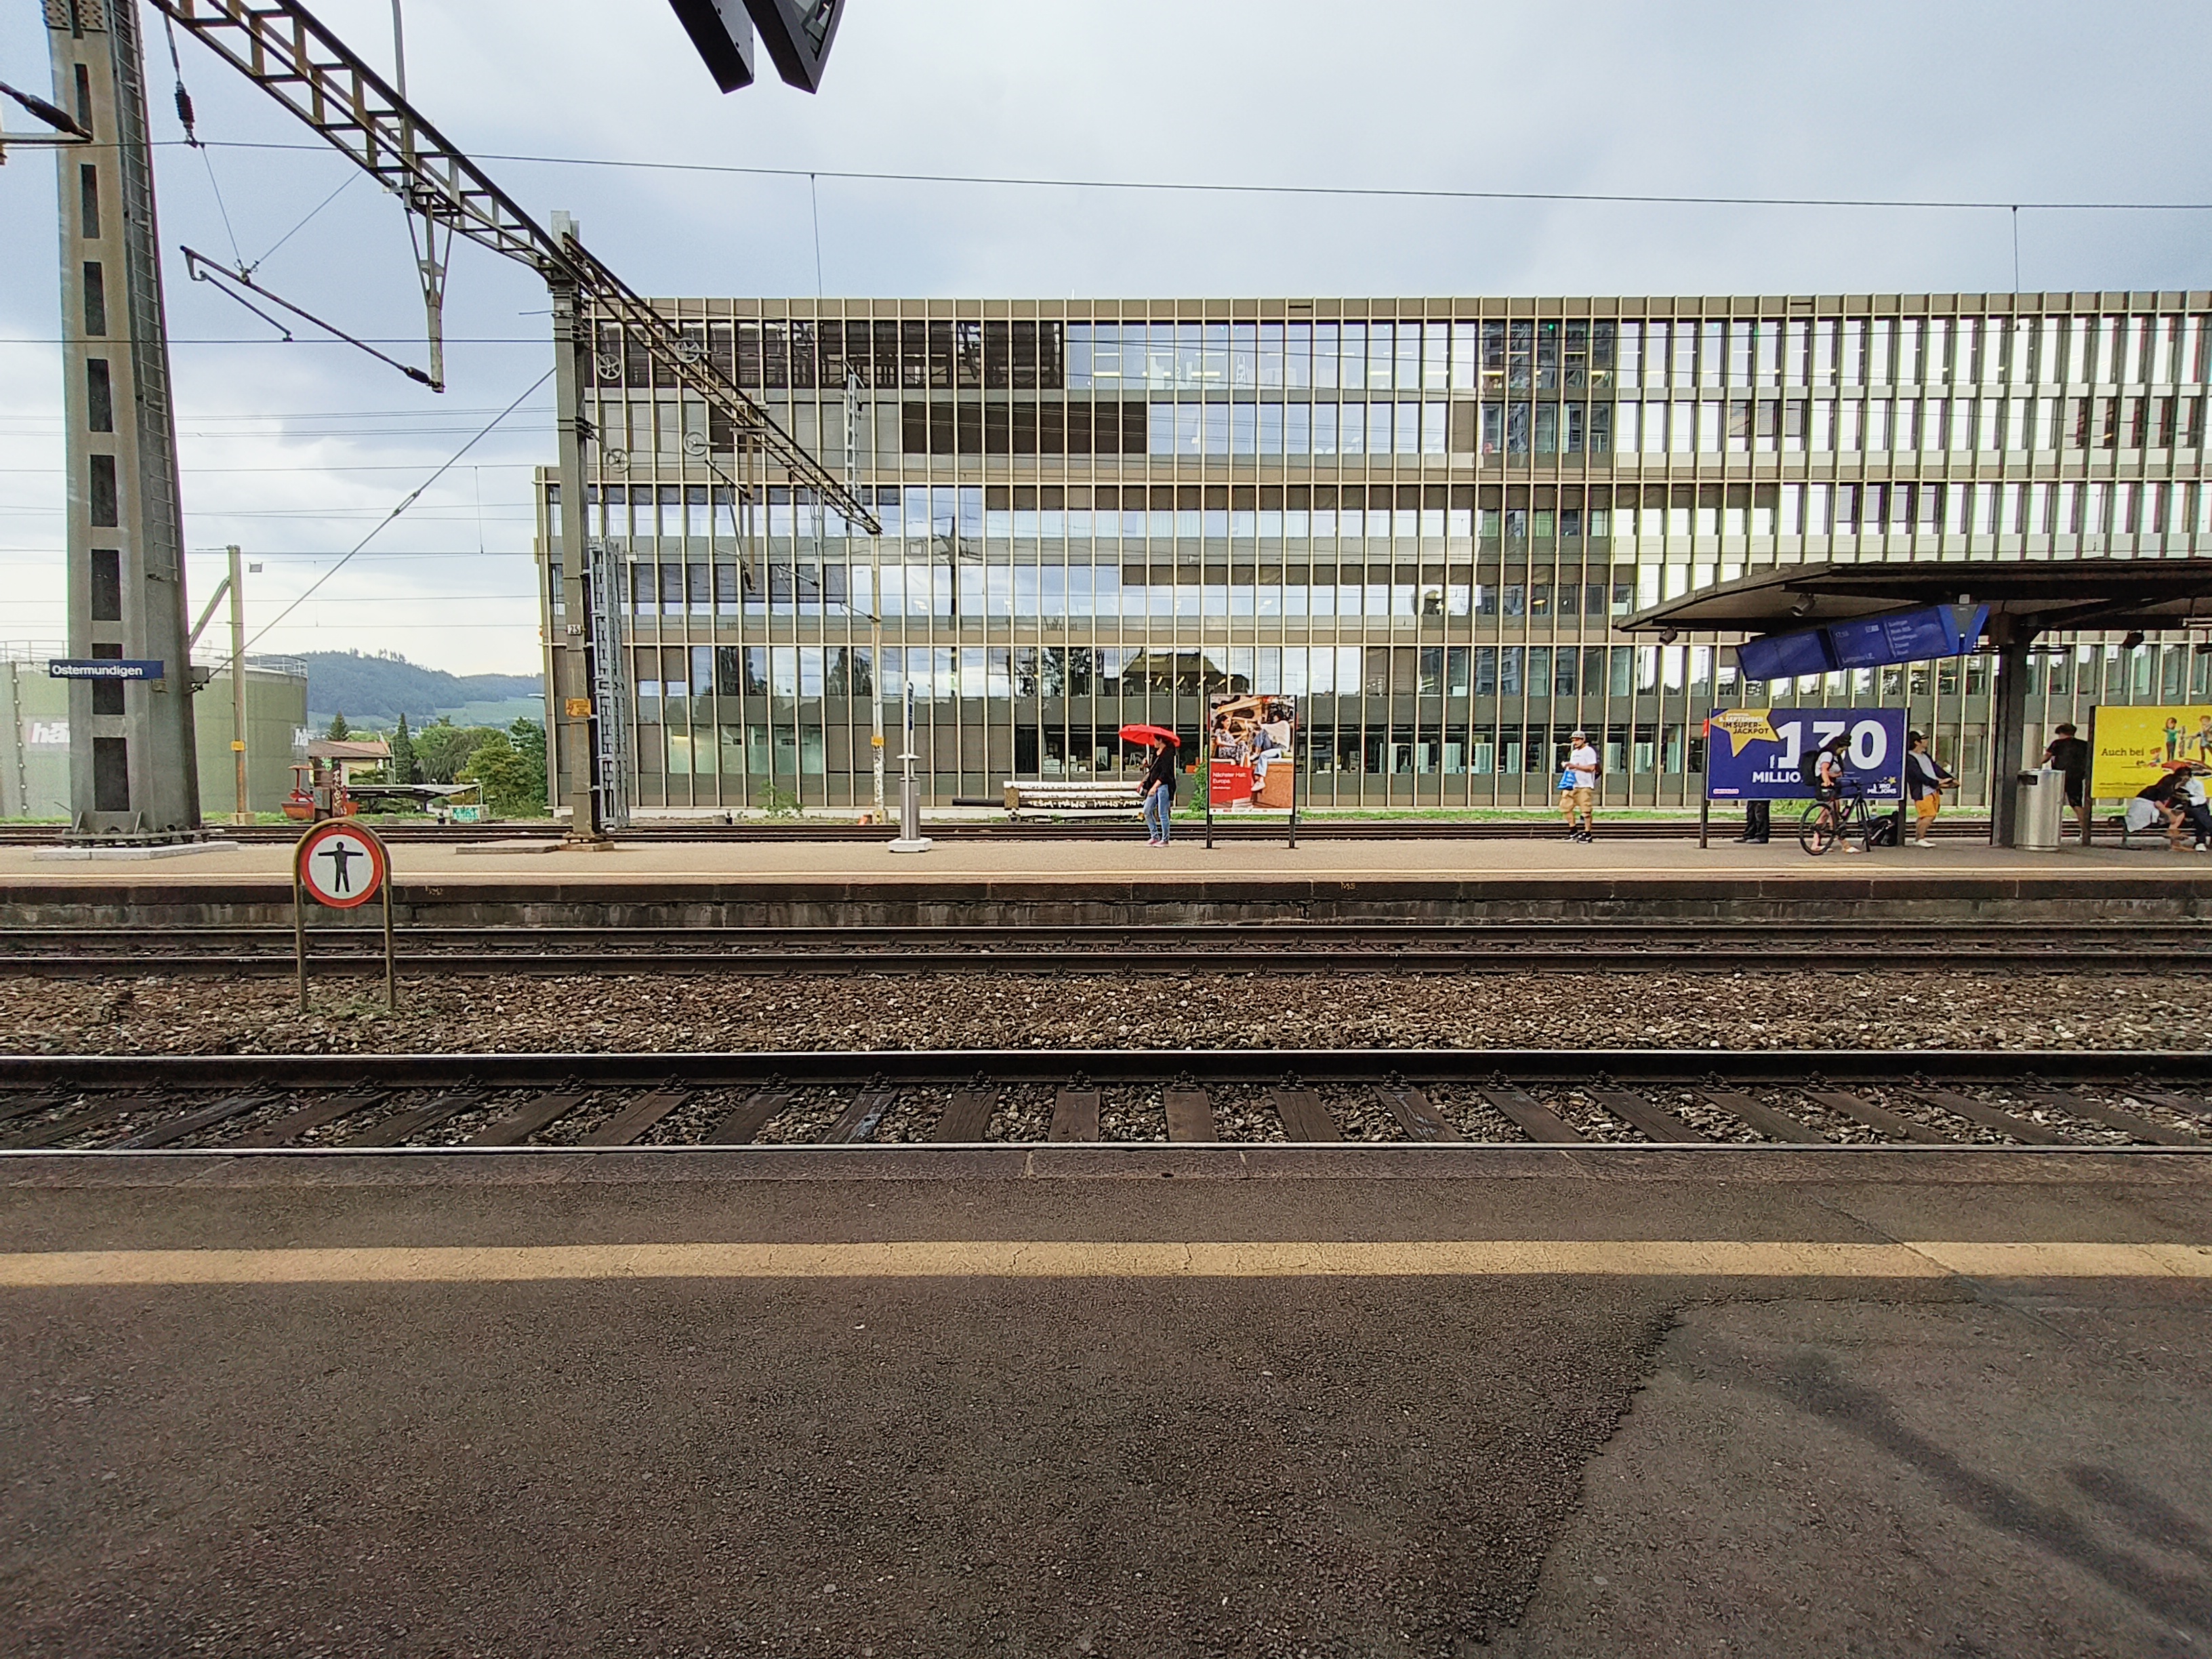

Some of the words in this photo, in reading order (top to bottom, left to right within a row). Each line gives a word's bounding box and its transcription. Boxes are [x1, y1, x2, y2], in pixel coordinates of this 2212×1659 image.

[569, 625, 579, 634] 25
[52, 665, 143, 677] Ostermundigen
[31, 722, 70, 744] hä
[2101, 747, 2127, 756] Auch
[2129, 747, 2145, 756] bei
[1753, 771, 1804, 783] MILLIO
